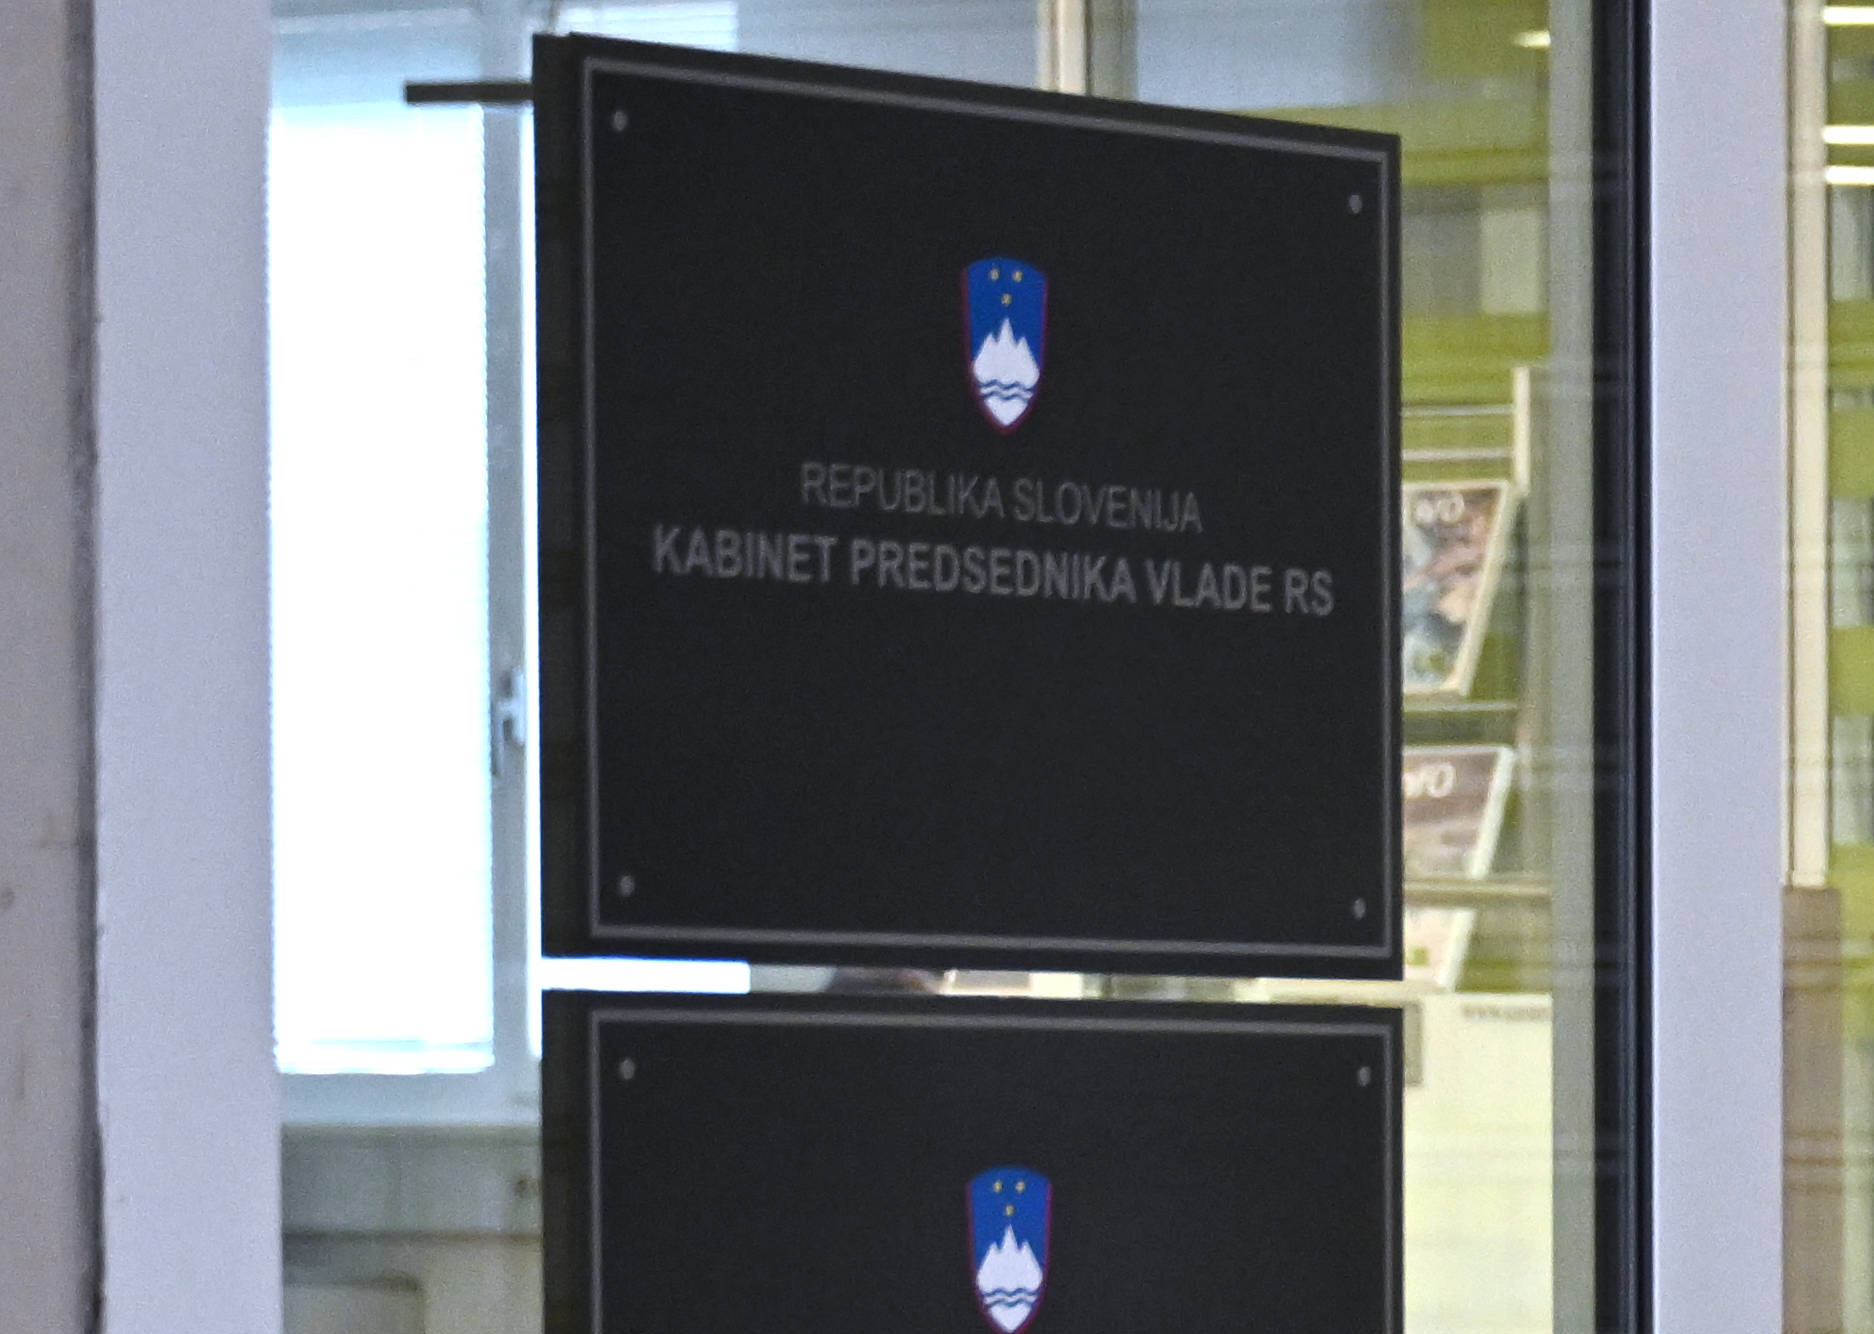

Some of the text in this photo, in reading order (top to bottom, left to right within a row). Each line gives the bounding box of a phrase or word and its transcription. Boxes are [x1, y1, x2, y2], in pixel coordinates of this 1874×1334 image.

[800, 461, 1203, 533] REPUBLIKA SLOVENIJA
[652, 524, 1335, 616] KABINET PREDSEDNIKA VLADE RS
